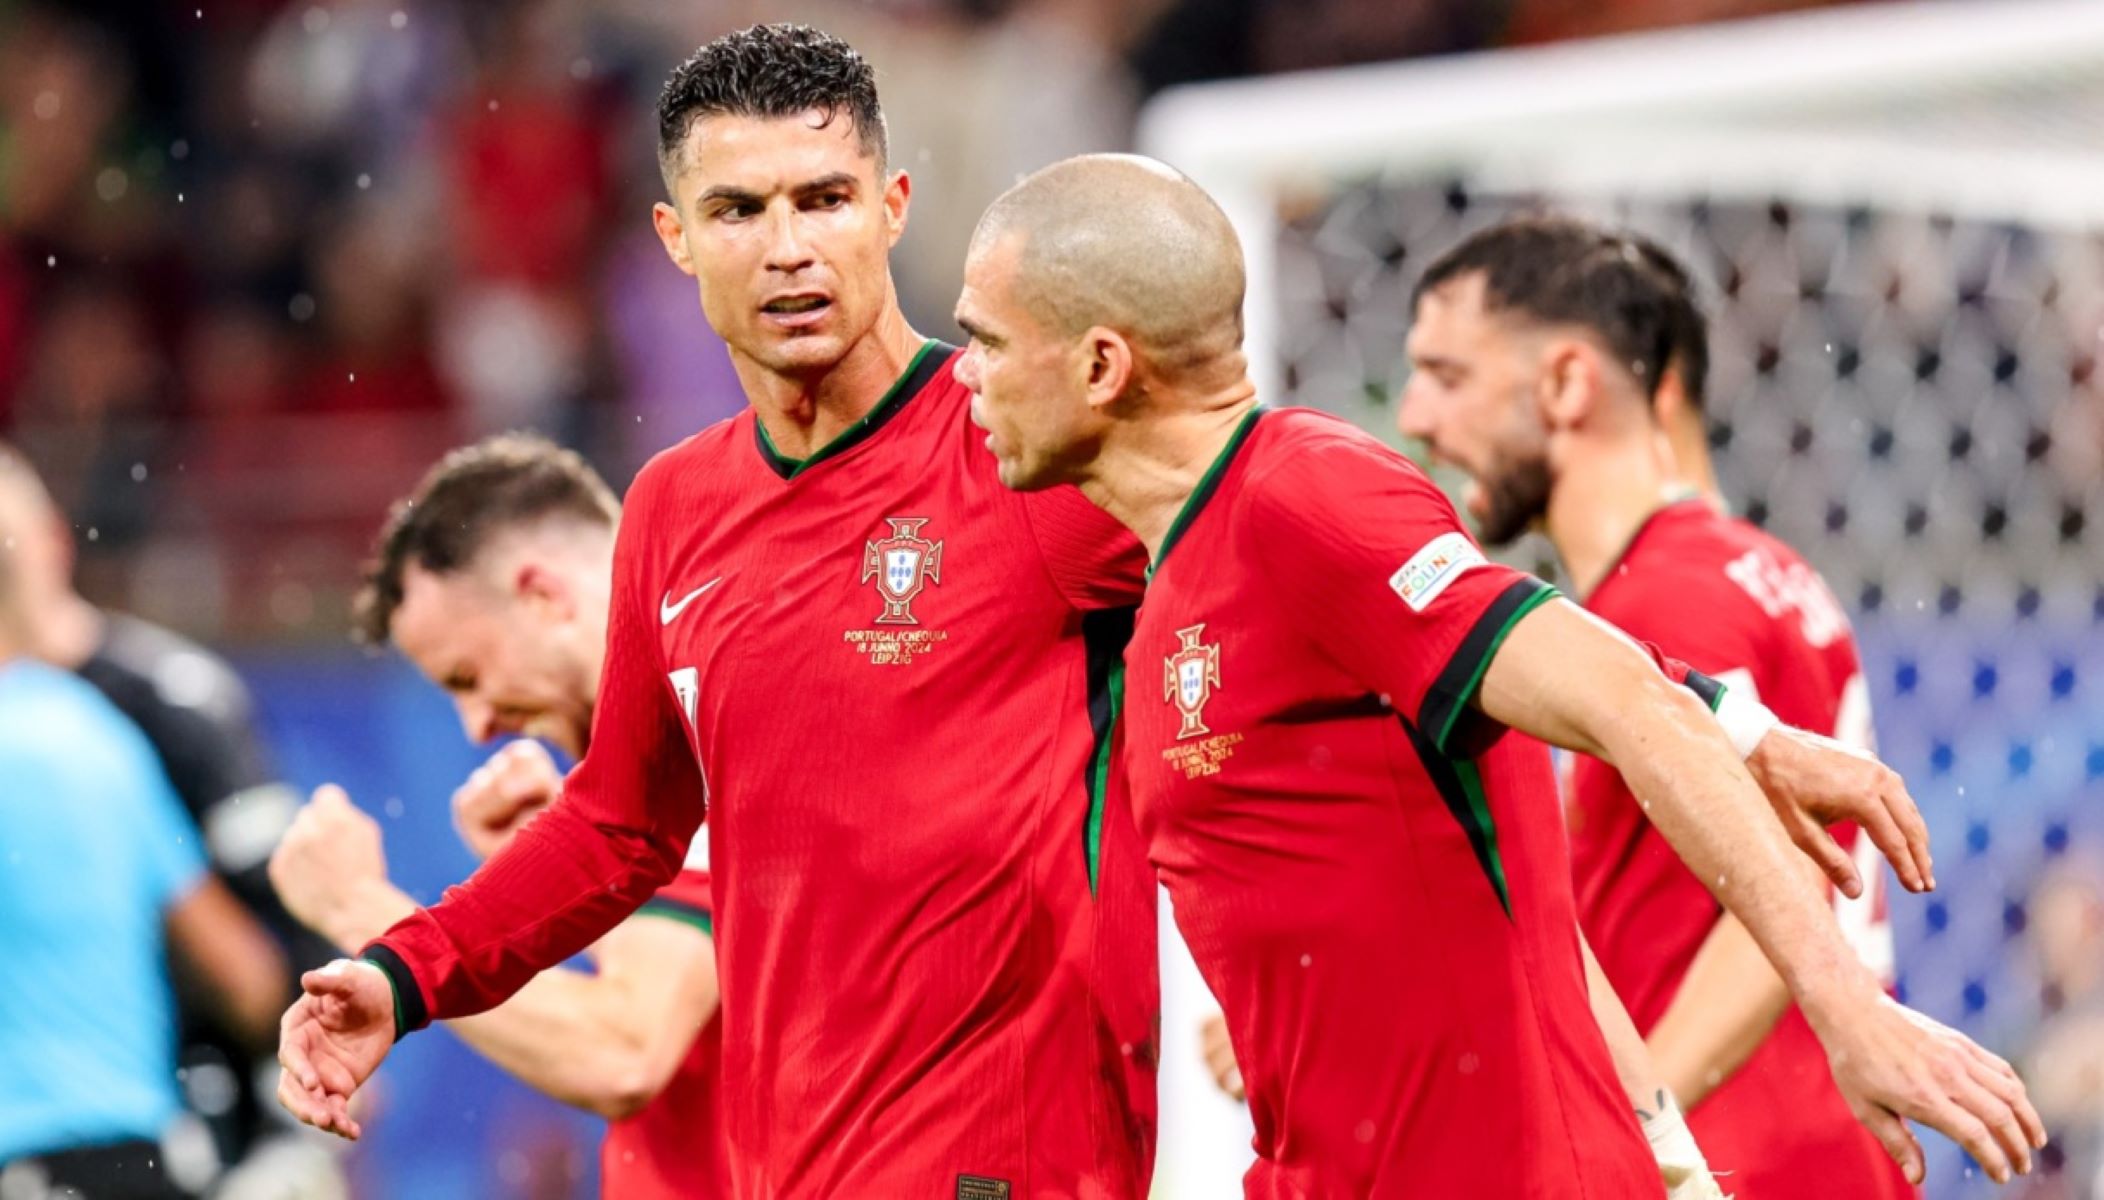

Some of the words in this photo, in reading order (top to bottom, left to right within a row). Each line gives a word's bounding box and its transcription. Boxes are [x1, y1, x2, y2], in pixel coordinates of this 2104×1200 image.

[868, 642, 900, 653] JUNHO
[904, 642, 931, 653] 2024
[871, 653, 911, 664] LEIPZIG
